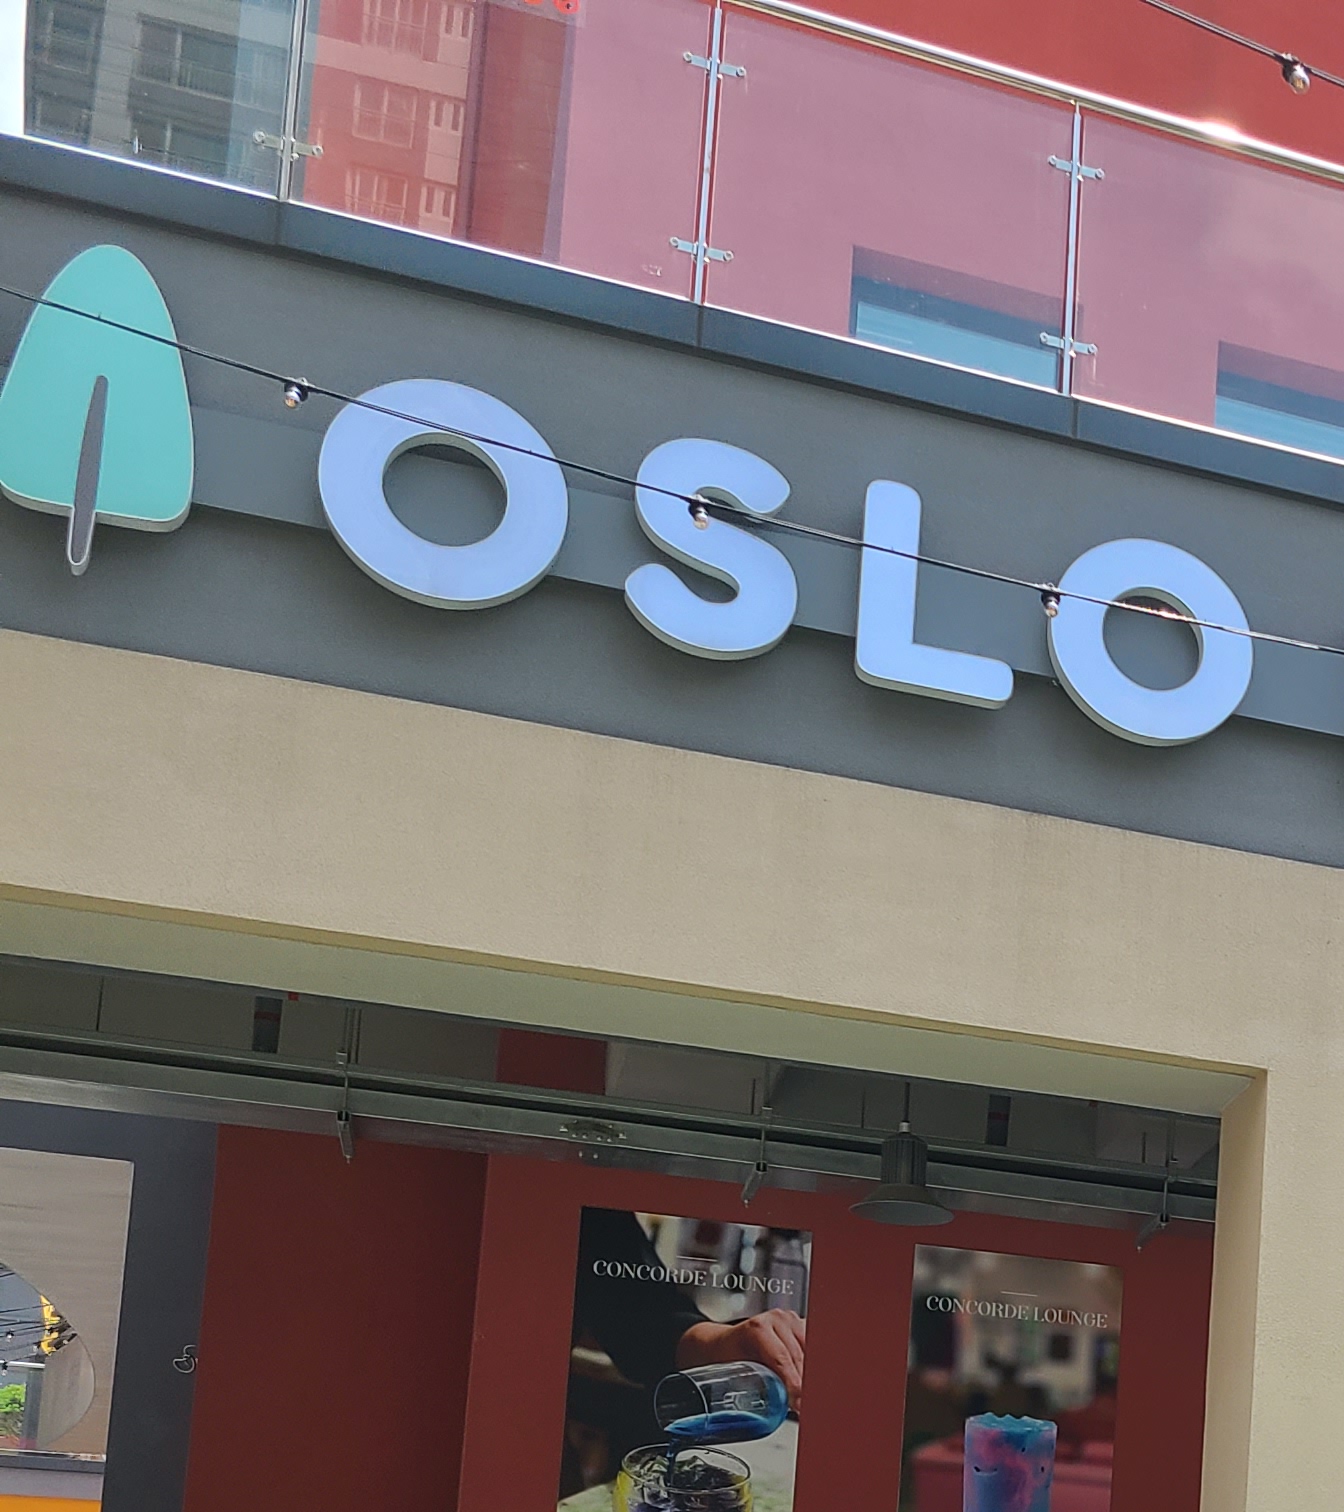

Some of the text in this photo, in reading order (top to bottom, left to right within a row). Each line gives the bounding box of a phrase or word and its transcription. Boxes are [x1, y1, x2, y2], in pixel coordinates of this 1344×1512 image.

[318, 378, 1254, 747] OSLO
[592, 1259, 794, 1296] CONCORDE LOUNGE
[926, 1295, 1108, 1329] CONCORDE LOUNGE
